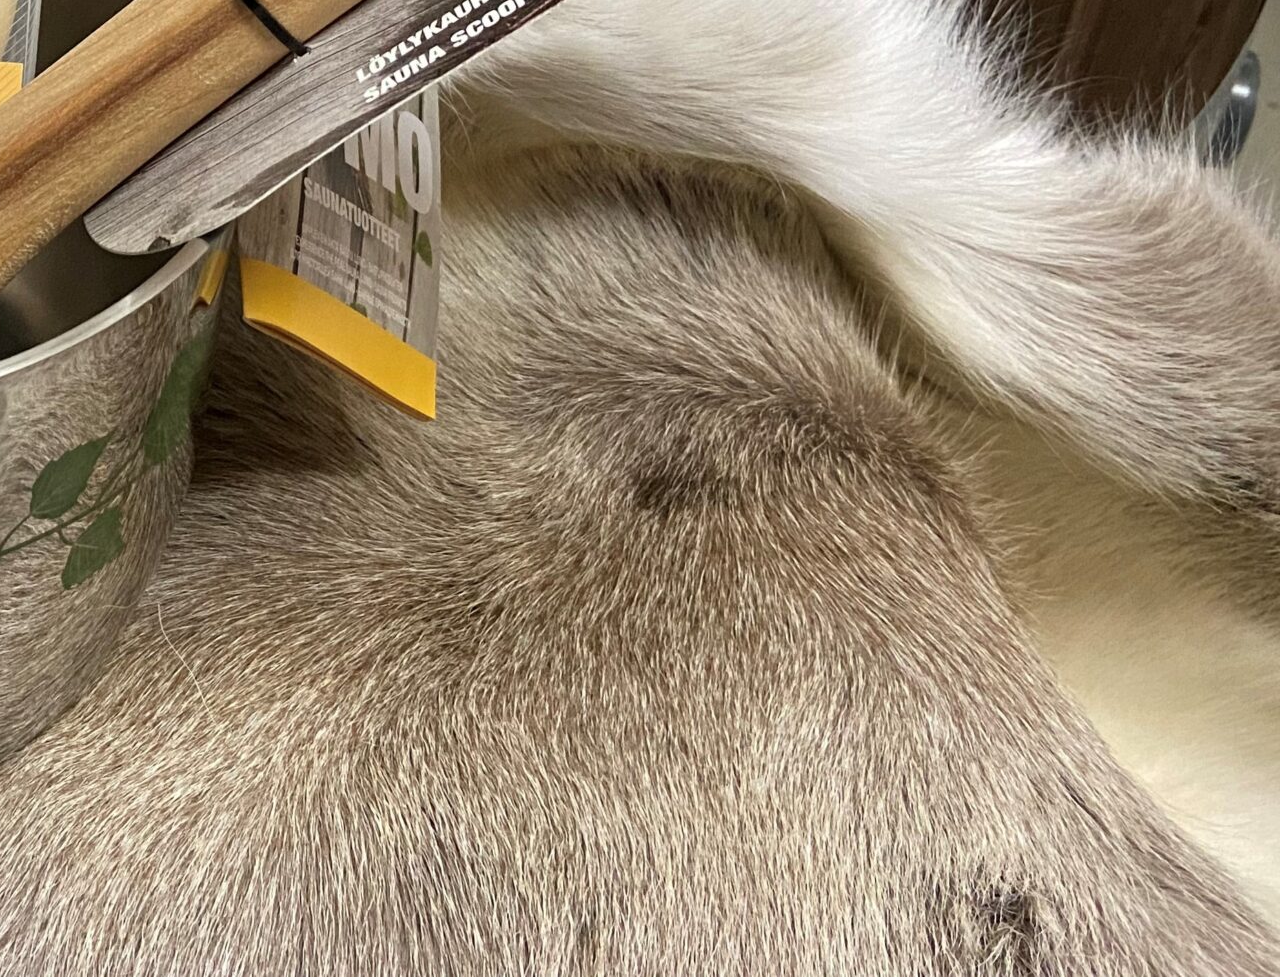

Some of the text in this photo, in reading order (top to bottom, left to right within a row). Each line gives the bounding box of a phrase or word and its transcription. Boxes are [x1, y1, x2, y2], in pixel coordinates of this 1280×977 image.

[363, 43, 448, 104] SAUNA
[344, 110, 433, 215] MO
[303, 176, 401, 253] SAUNATUOTTEET
